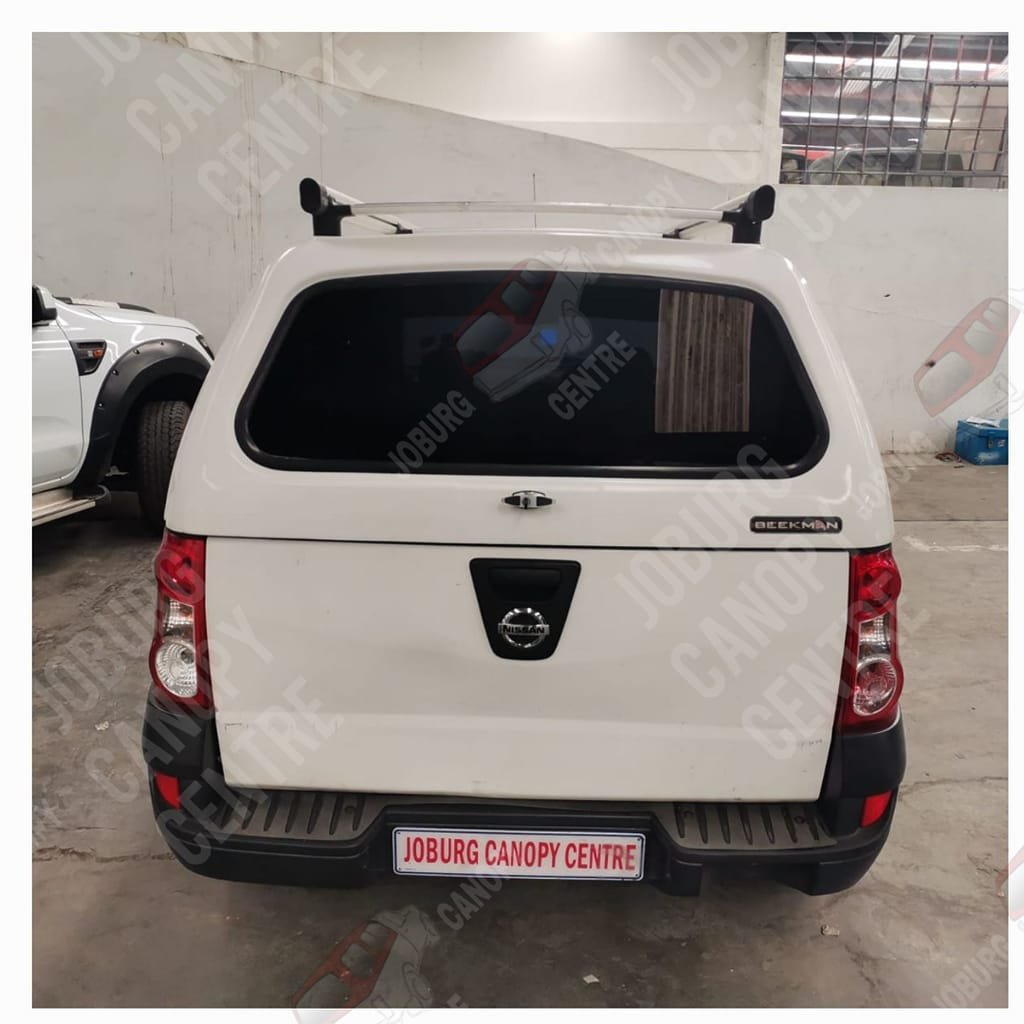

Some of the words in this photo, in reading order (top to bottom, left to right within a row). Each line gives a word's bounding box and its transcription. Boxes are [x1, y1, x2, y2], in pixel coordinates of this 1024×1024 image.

[754, 521, 839, 531] BEEKMAN
[502, 625, 546, 635] NISSAN
[404, 836, 479, 866] JOBURG
[484, 839, 562, 869] CANOPY
[564, 842, 637, 872] CENTRE
